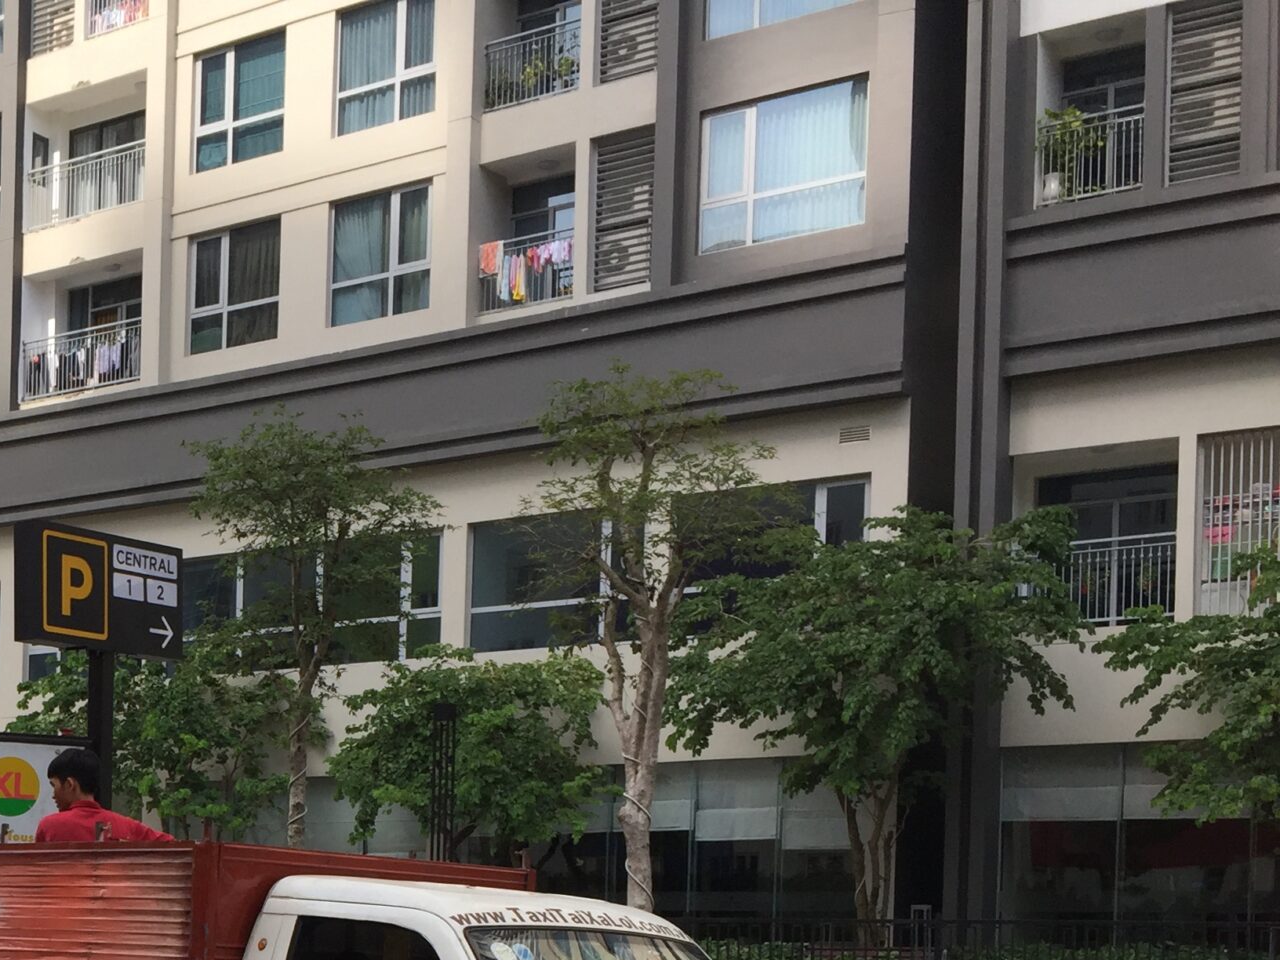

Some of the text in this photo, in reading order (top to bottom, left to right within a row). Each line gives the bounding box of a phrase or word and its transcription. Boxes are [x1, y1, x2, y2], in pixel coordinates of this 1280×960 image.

[115, 549, 175, 576] CENTRAL
[60, 553, 94, 617] P
[124, 578, 166, 602] 1 2
